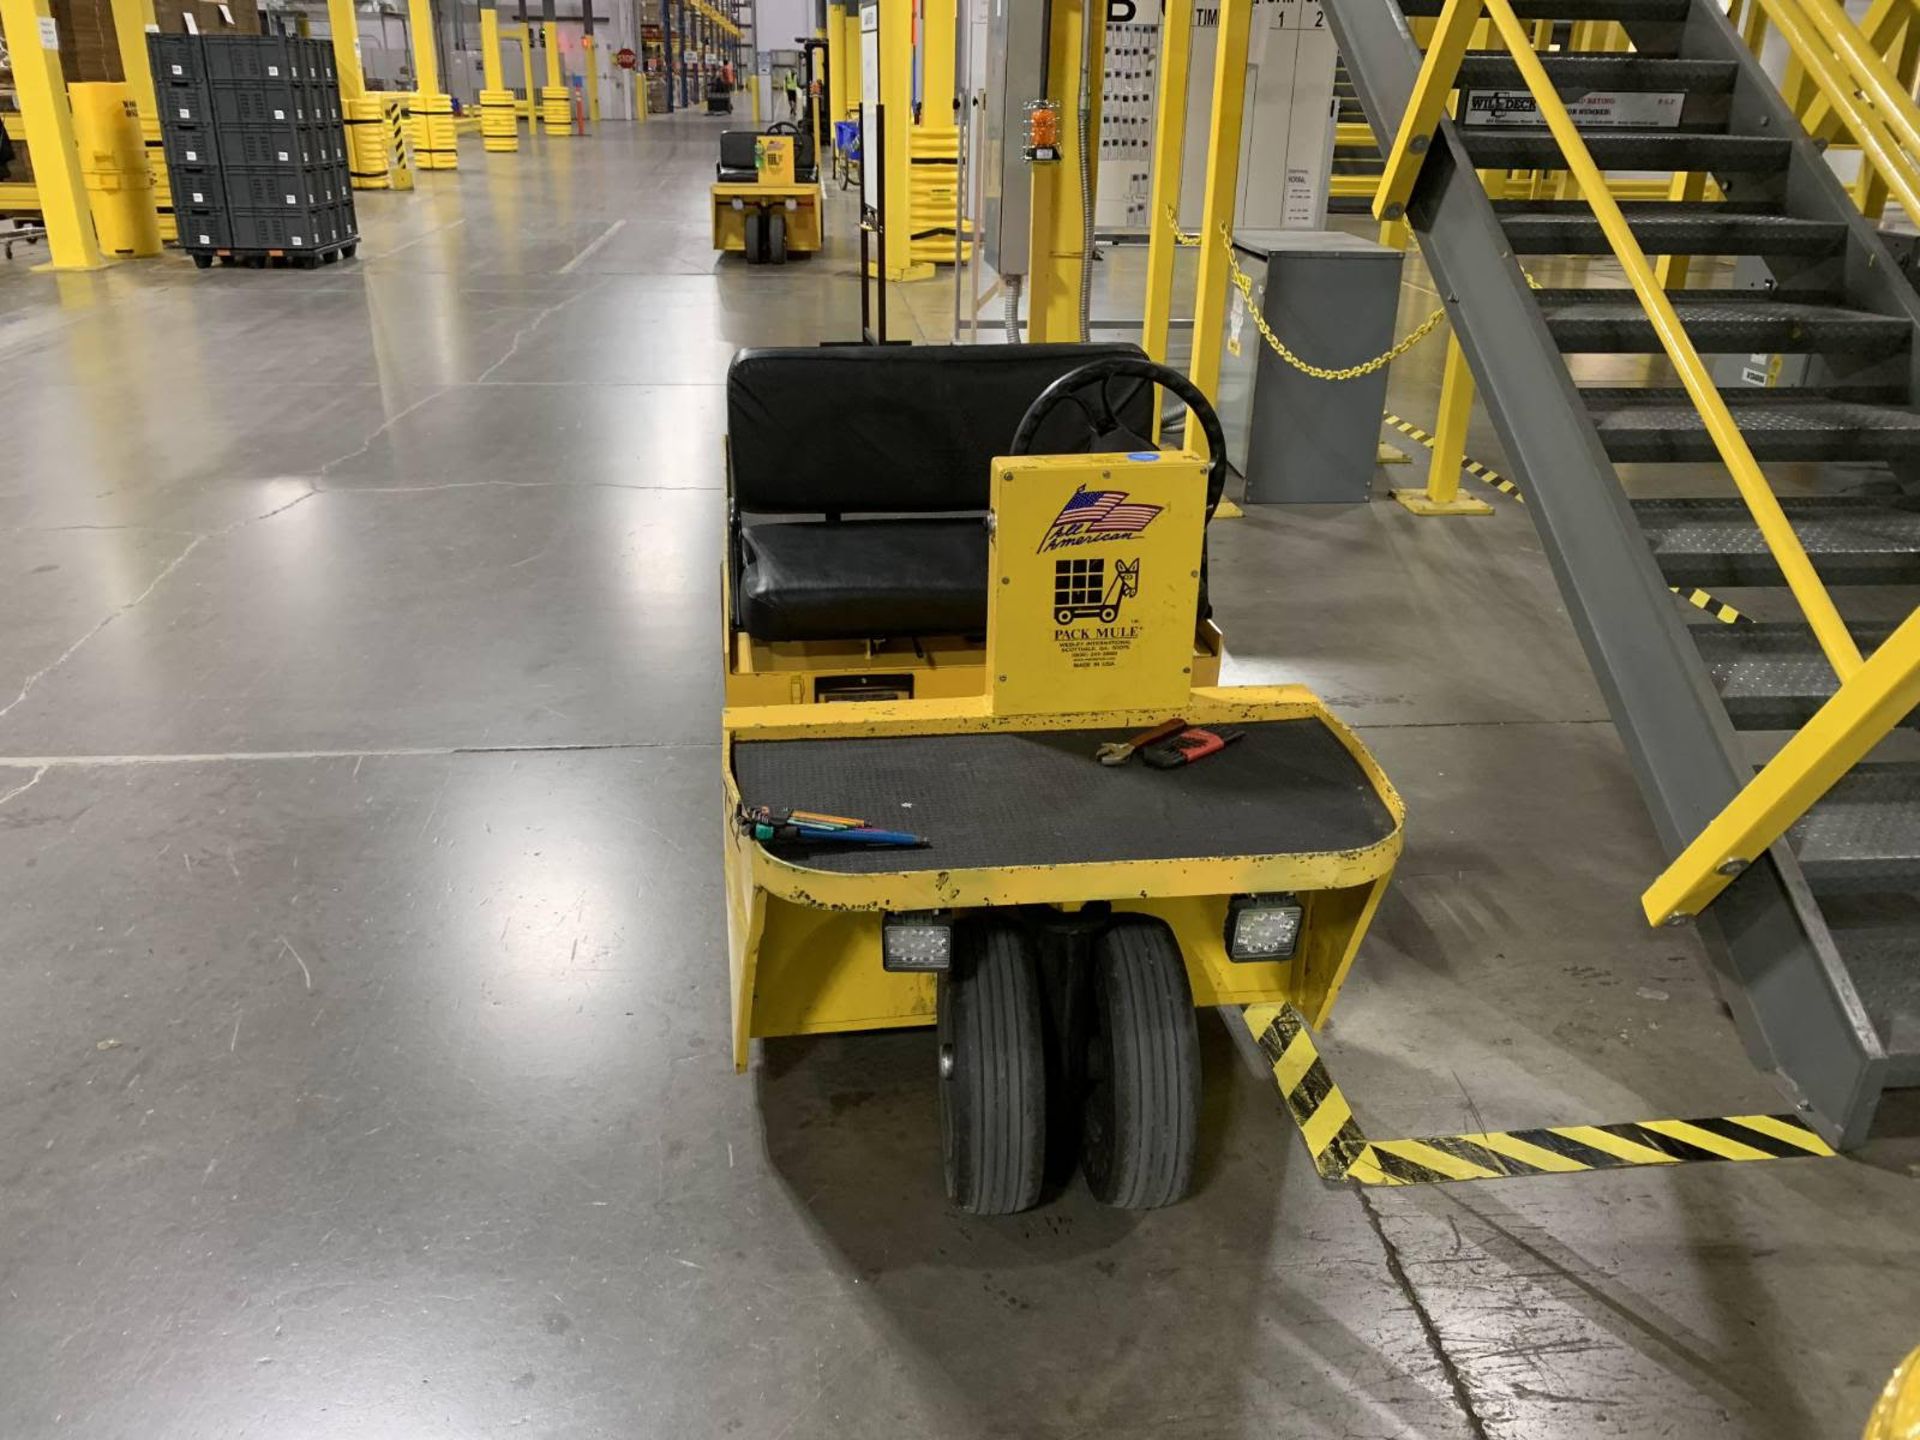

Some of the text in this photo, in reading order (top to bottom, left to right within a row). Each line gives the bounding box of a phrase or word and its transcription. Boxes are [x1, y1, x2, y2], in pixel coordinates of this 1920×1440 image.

[1196, 8, 1220, 26] TIM
[1278, 11, 1285, 27] 1
[1314, 11, 1324, 27] 2
[1049, 523, 1085, 540] All
[1044, 532, 1144, 553] American
[1055, 628, 1090, 640] PACK
